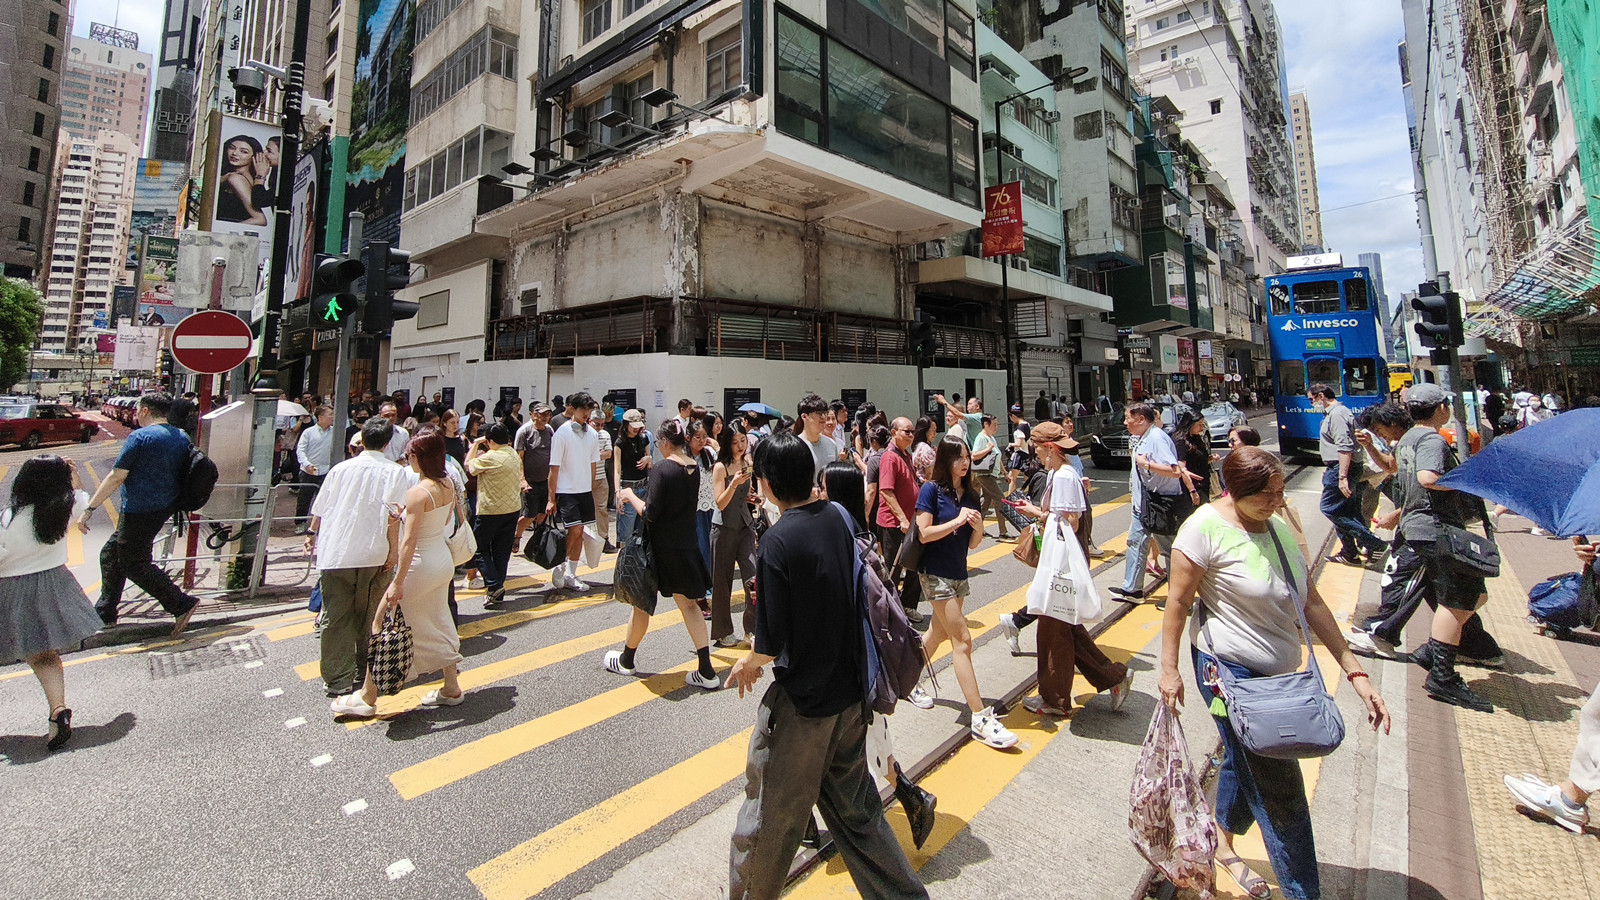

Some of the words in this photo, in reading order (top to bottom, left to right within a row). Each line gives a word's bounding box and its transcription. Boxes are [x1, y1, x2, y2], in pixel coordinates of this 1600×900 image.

[990, 186, 1011, 209] 76
[1301, 256, 1323, 267] 26
[1352, 271, 1363, 279] 26
[1302, 318, 1359, 330] Invesco
